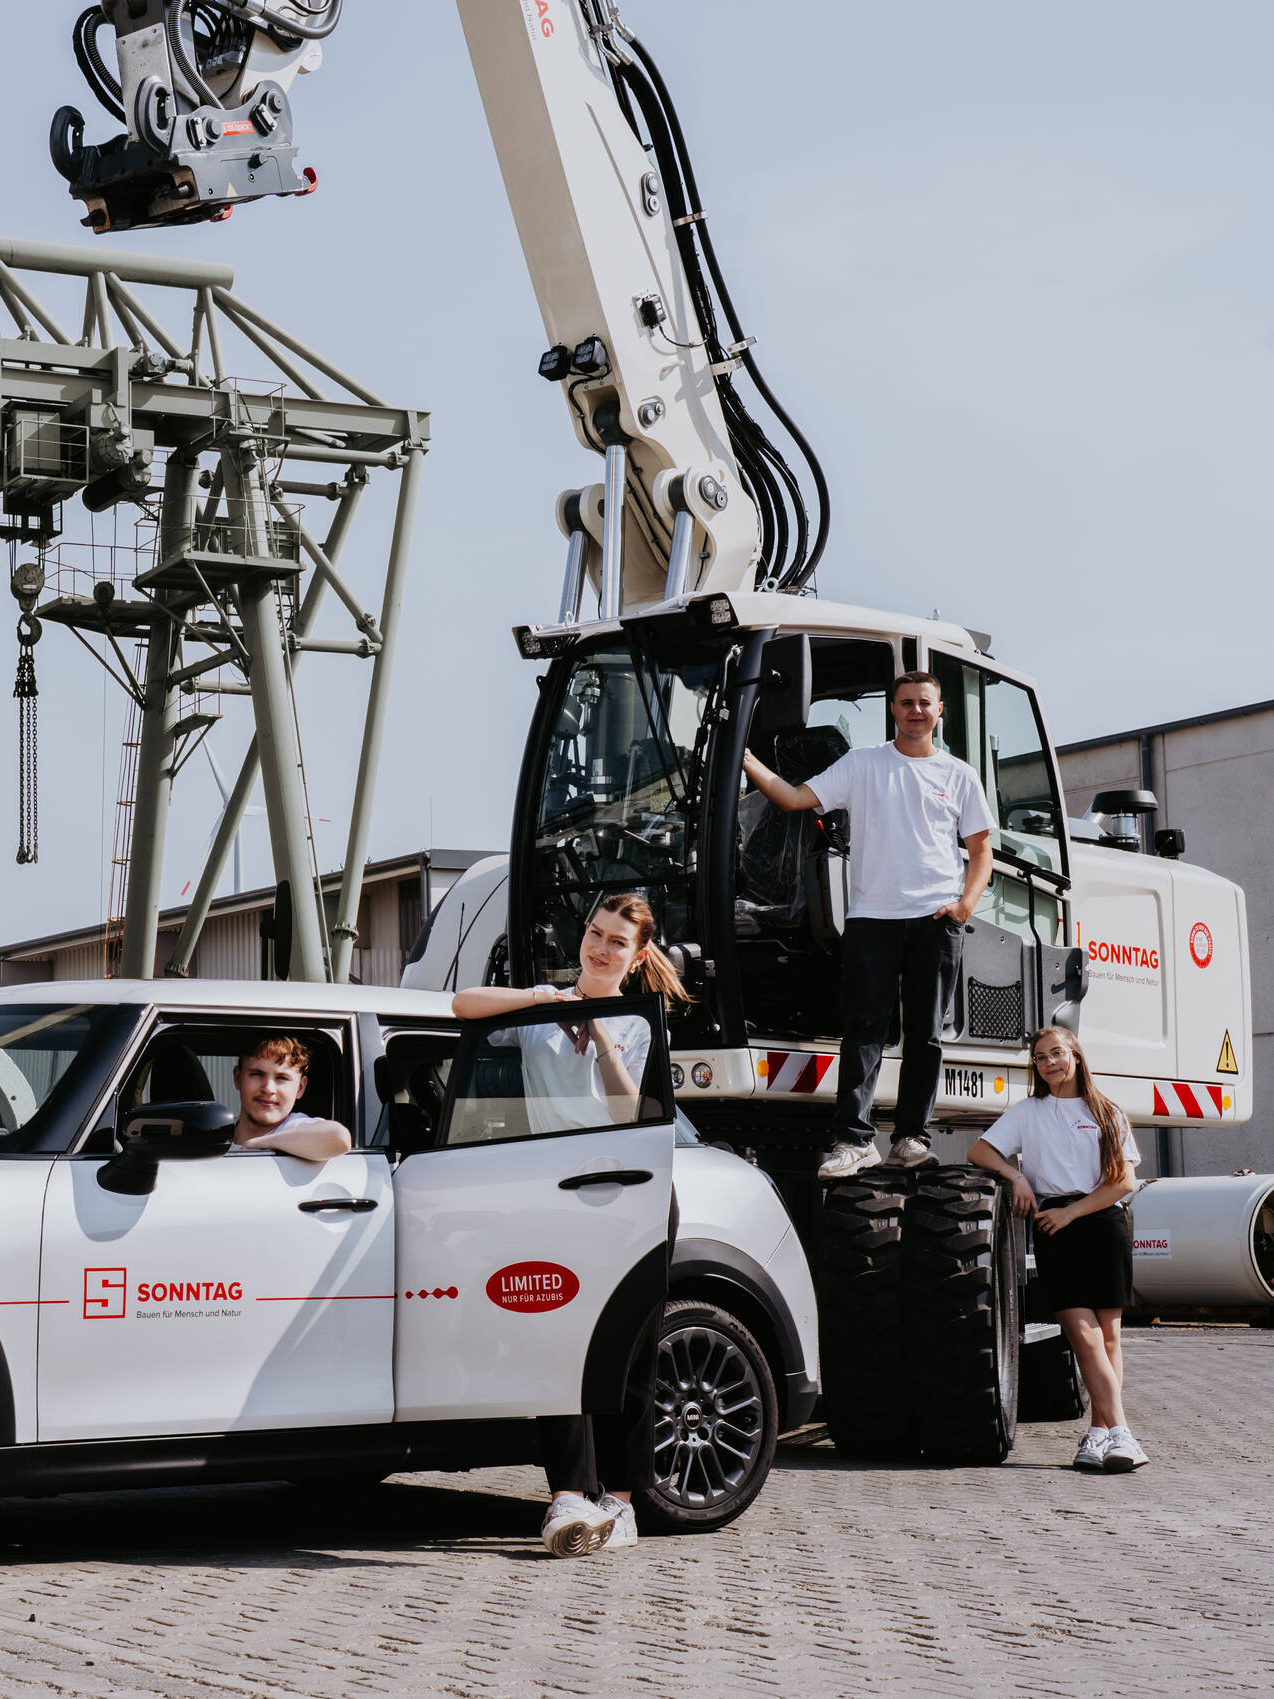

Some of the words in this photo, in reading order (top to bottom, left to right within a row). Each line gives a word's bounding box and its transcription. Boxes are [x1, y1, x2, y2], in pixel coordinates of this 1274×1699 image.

[1087, 940, 1158, 969] SONNTAG
[1133, 1239, 1168, 1249] ONNTAG
[501, 1273, 562, 1292] LIMITED
[137, 1282, 243, 1302] SONNTAG
[502, 1295, 518, 1303] NUR
[519, 1293, 534, 1302] FÜR
[536, 1292, 564, 1302] AZUBIS
[136, 1311, 161, 1319] Bauen
[162, 1310, 172, 1318] für
[174, 1310, 204, 1318] Mensch
[205, 1309, 220, 1317] und
[221, 1309, 241, 1317] Natur
